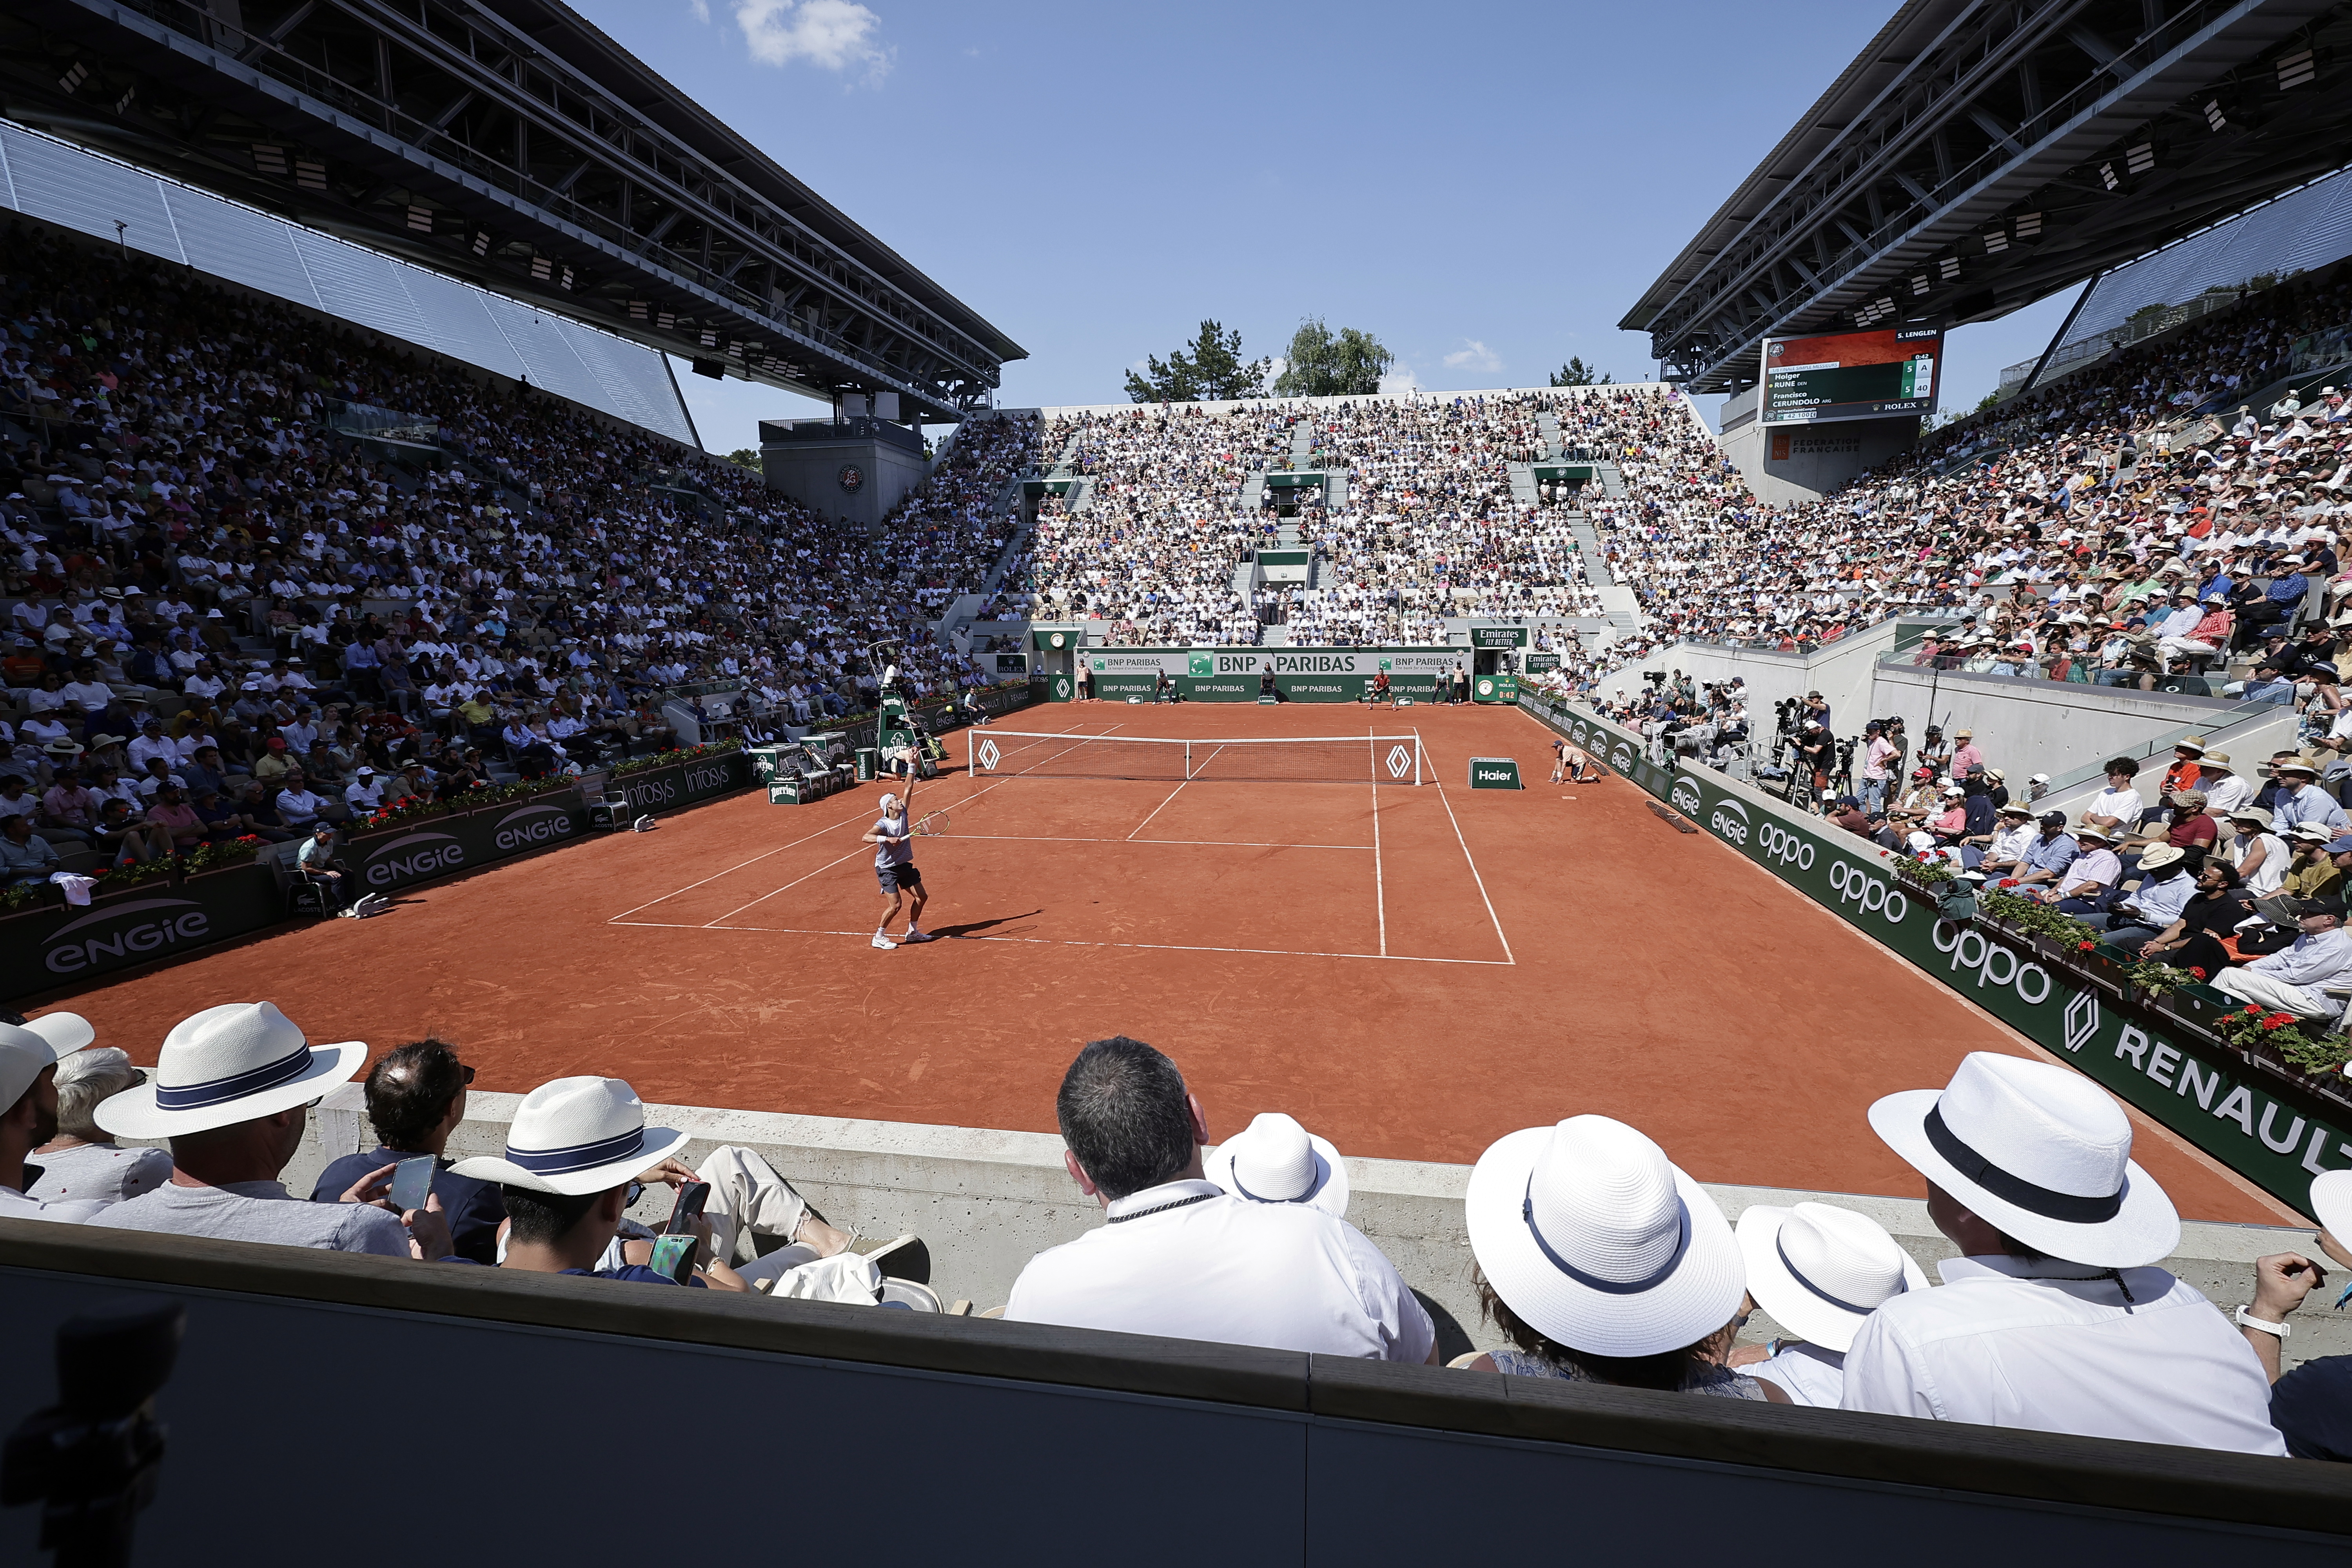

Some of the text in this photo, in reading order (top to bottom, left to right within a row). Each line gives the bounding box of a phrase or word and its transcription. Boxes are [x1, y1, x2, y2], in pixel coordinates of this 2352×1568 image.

[1906, 329, 1937, 338] LENGLEN
[1773, 398, 1820, 407] CERUNDOLO
[1884, 402, 1917, 410] ROLEX
[1793, 445, 1860, 454] FRANÇAISE
[839, 466, 863, 482] ROLAND GARROS
[1480, 630, 1519, 638] Emirates
[1220, 656, 1355, 671] BNP PARIBAS
[1010, 691, 1028, 702] RENAULT
[980, 699, 999, 710] ENAULT
[812, 752, 829, 770] HEAD
[684, 765, 729, 793] Infosys
[1479, 770, 1512, 780] Haier
[621, 779, 675, 808] Infosys
[771, 784, 796, 803] perrier
[1759, 822, 1816, 871] oppo
[1829, 860, 1907, 924] oppo
[1932, 918, 2052, 1004] oppo
